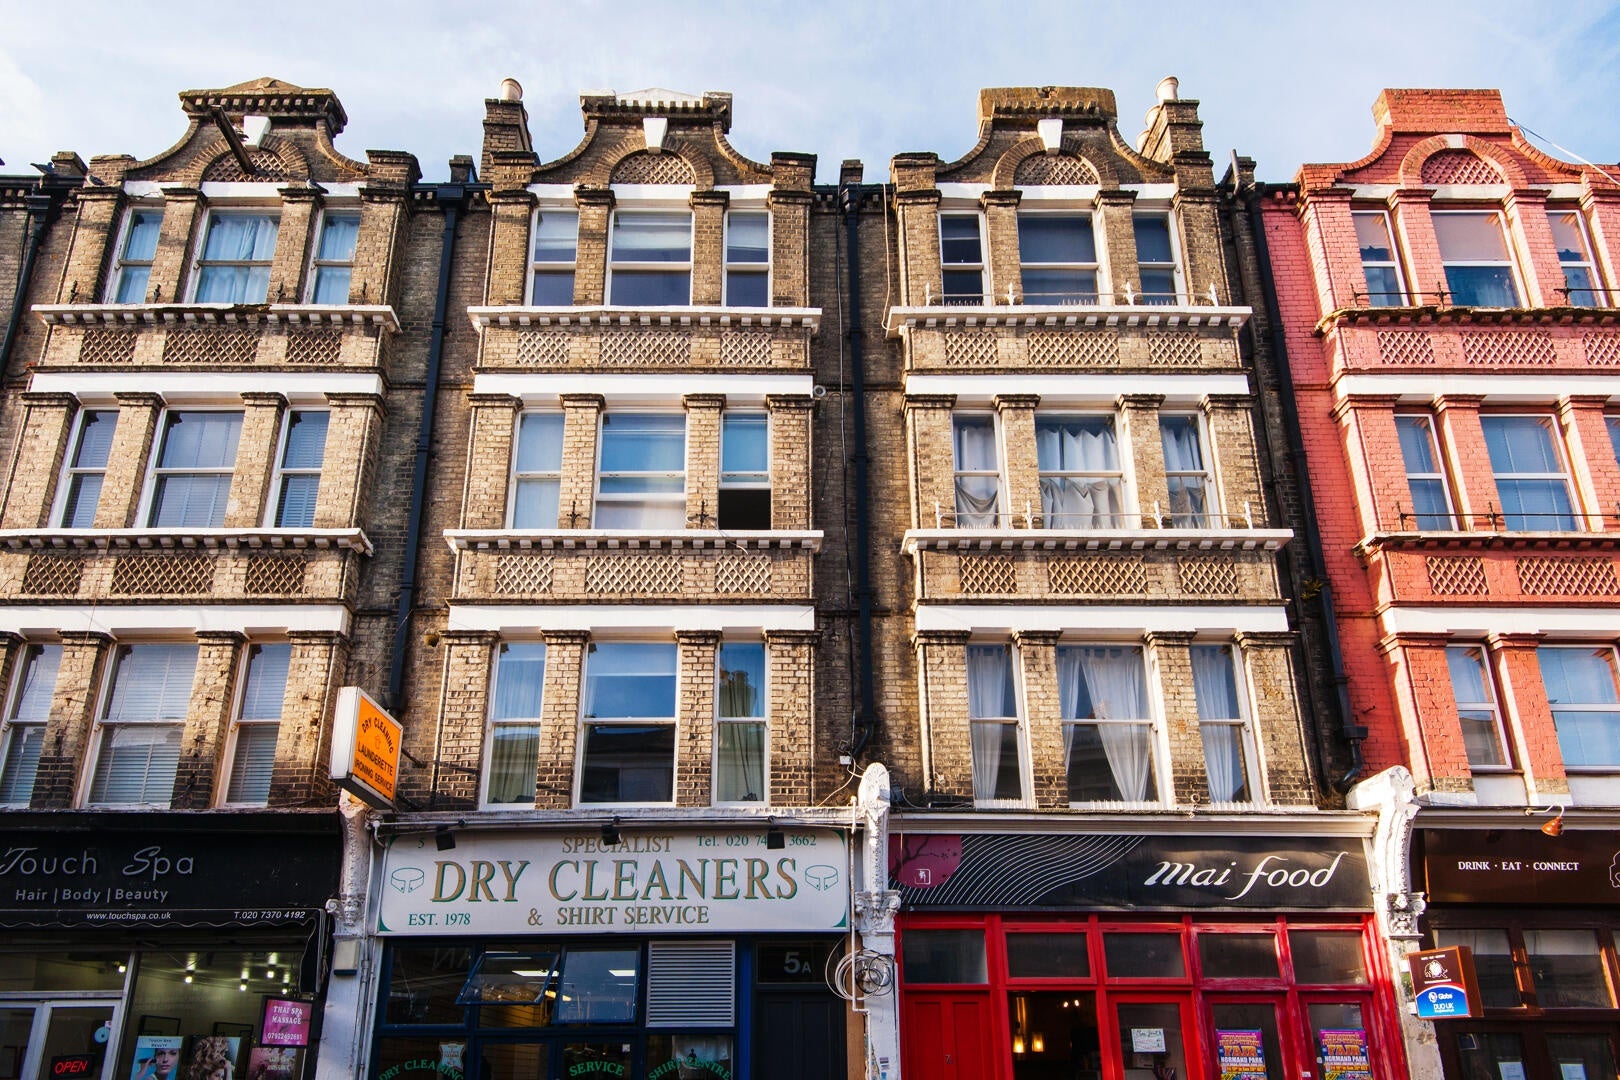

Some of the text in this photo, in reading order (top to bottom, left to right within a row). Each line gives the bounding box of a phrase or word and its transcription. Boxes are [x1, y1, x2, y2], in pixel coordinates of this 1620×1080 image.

[362, 717, 394, 754] DRY CLEANING
[358, 741, 393, 777] LAUNDERETTE
[355, 758, 393, 793] IRONING SERVICE
[696, 835, 720, 846] Tel.
[726, 835, 749, 846] 020
[789, 834, 817, 846] 3662
[0, 846, 194, 881] Touch Spa
[1458, 861, 1580, 871] DRINK EAT CONNECT
[430, 858, 798, 902] DRY CLEANERS
[1225, 851, 1349, 900] food
[15, 889, 169, 904] Hair Body Beauty
[86, 912, 171, 921] www.touchspa.co.uk
[260, 911, 282, 919] 7370
[284, 911, 306, 919] 4192
[408, 913, 471, 926] EST. 1978
[527, 906, 709, 926] & SHIRT SERVICE
[273, 1006, 302, 1015] THAI SPA
[272, 1015, 302, 1025] MASSAGE
[54, 1060, 88, 1075] OPEN
[569, 1060, 625, 1077] SERVICE
[649, 1057, 731, 1080] SHIRT CENTRE
